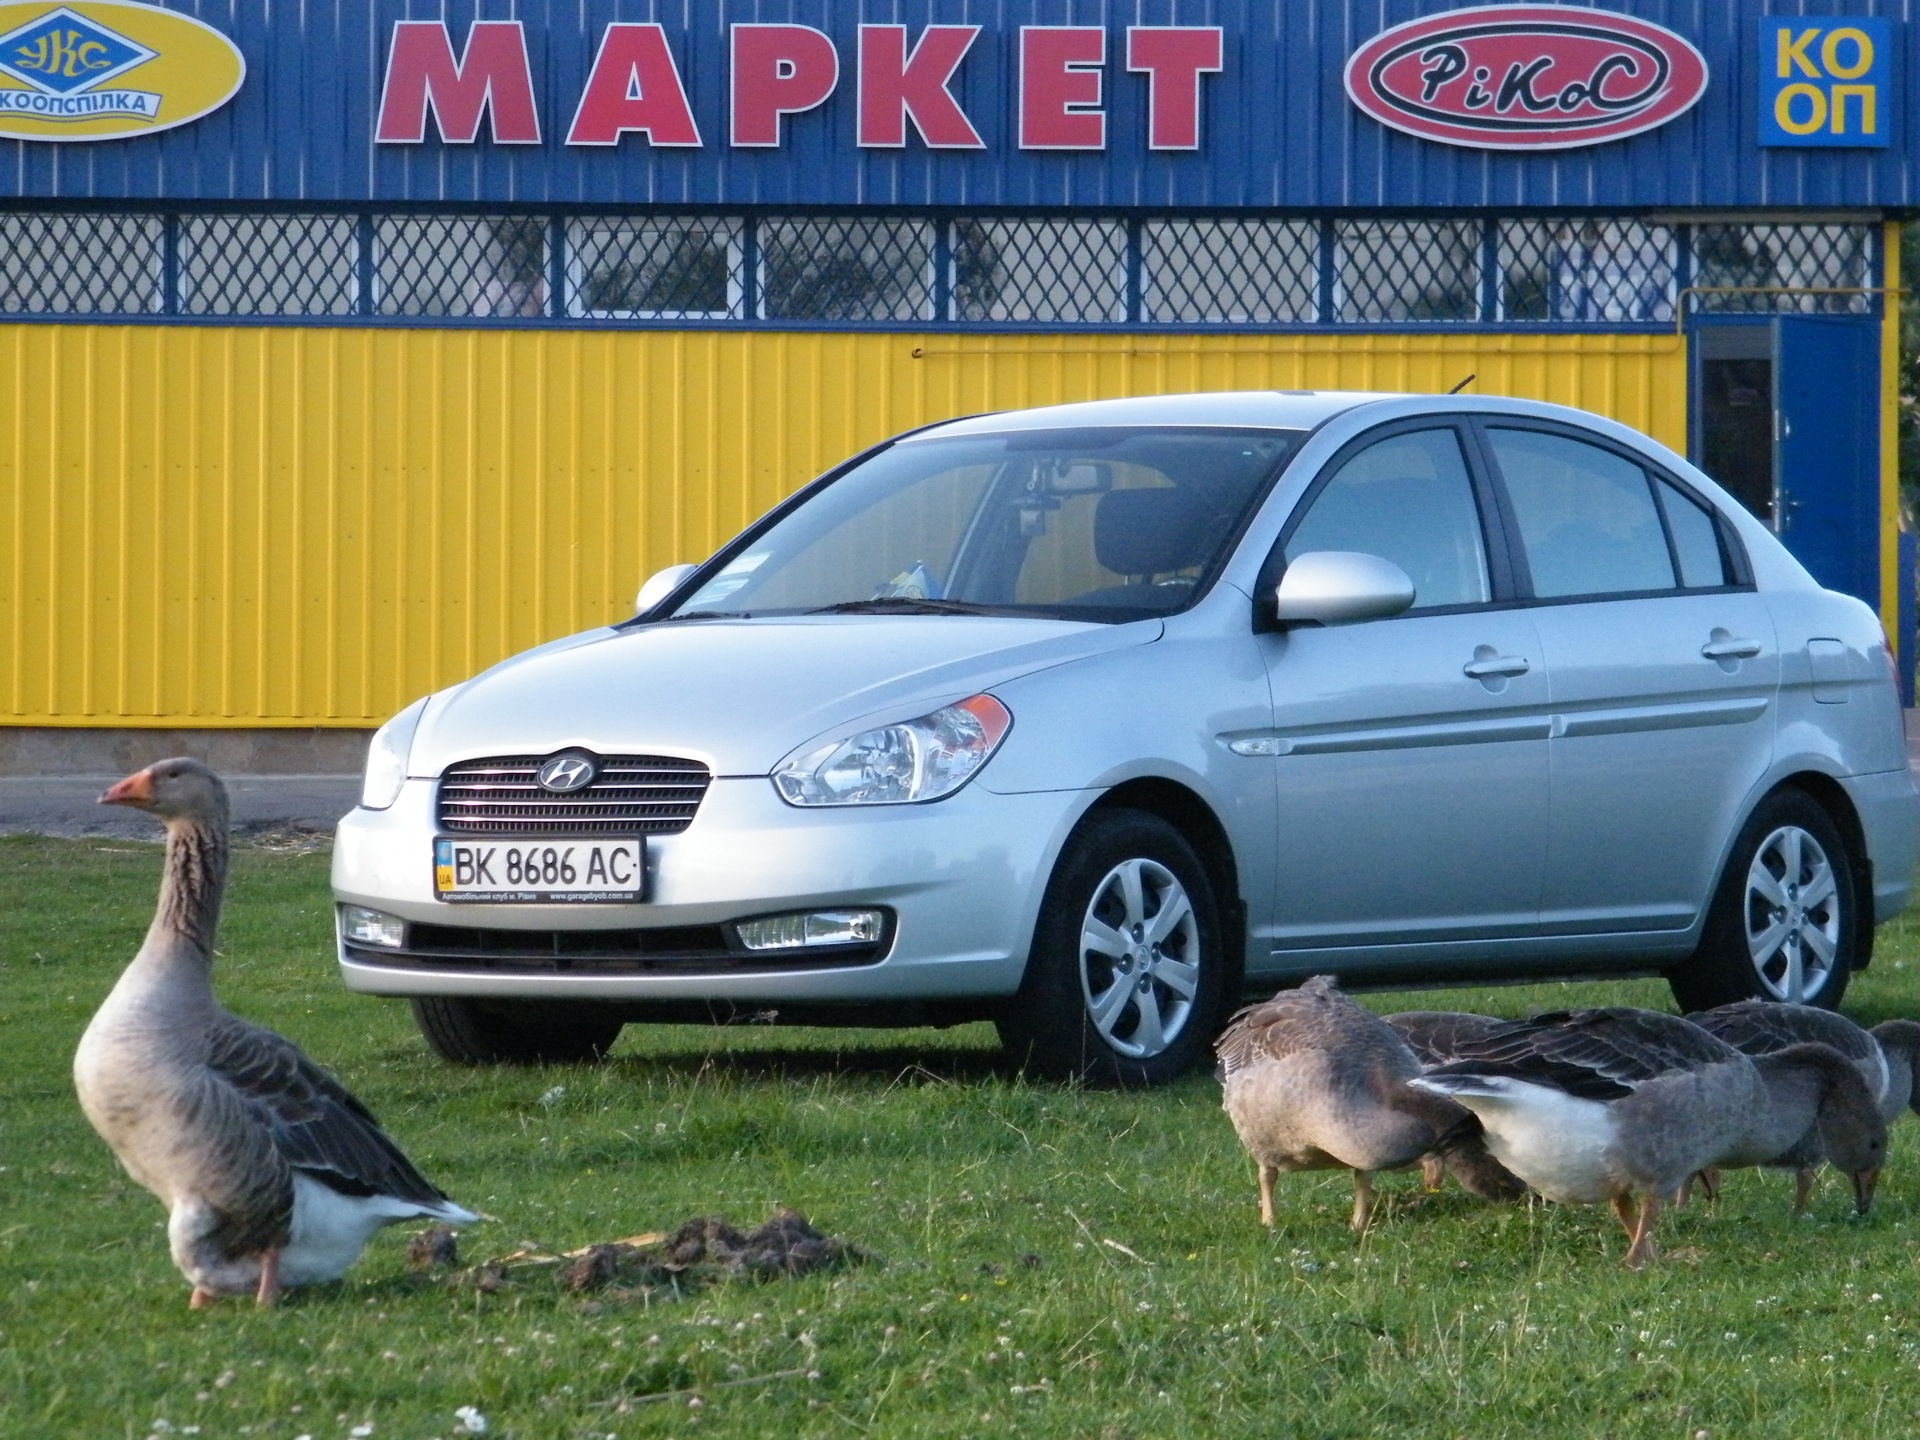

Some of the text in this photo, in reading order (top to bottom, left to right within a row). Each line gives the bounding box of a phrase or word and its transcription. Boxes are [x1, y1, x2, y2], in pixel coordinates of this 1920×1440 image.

[1776, 27, 1874, 79] КО
[0, 92, 146, 113] КООПСПІЛКА
[375, 19, 1224, 151] МАРКЕТ
[1774, 84, 1876, 135] ОП
[440, 873, 453, 885] UA
[455, 847, 632, 885] BK 8686 AC
